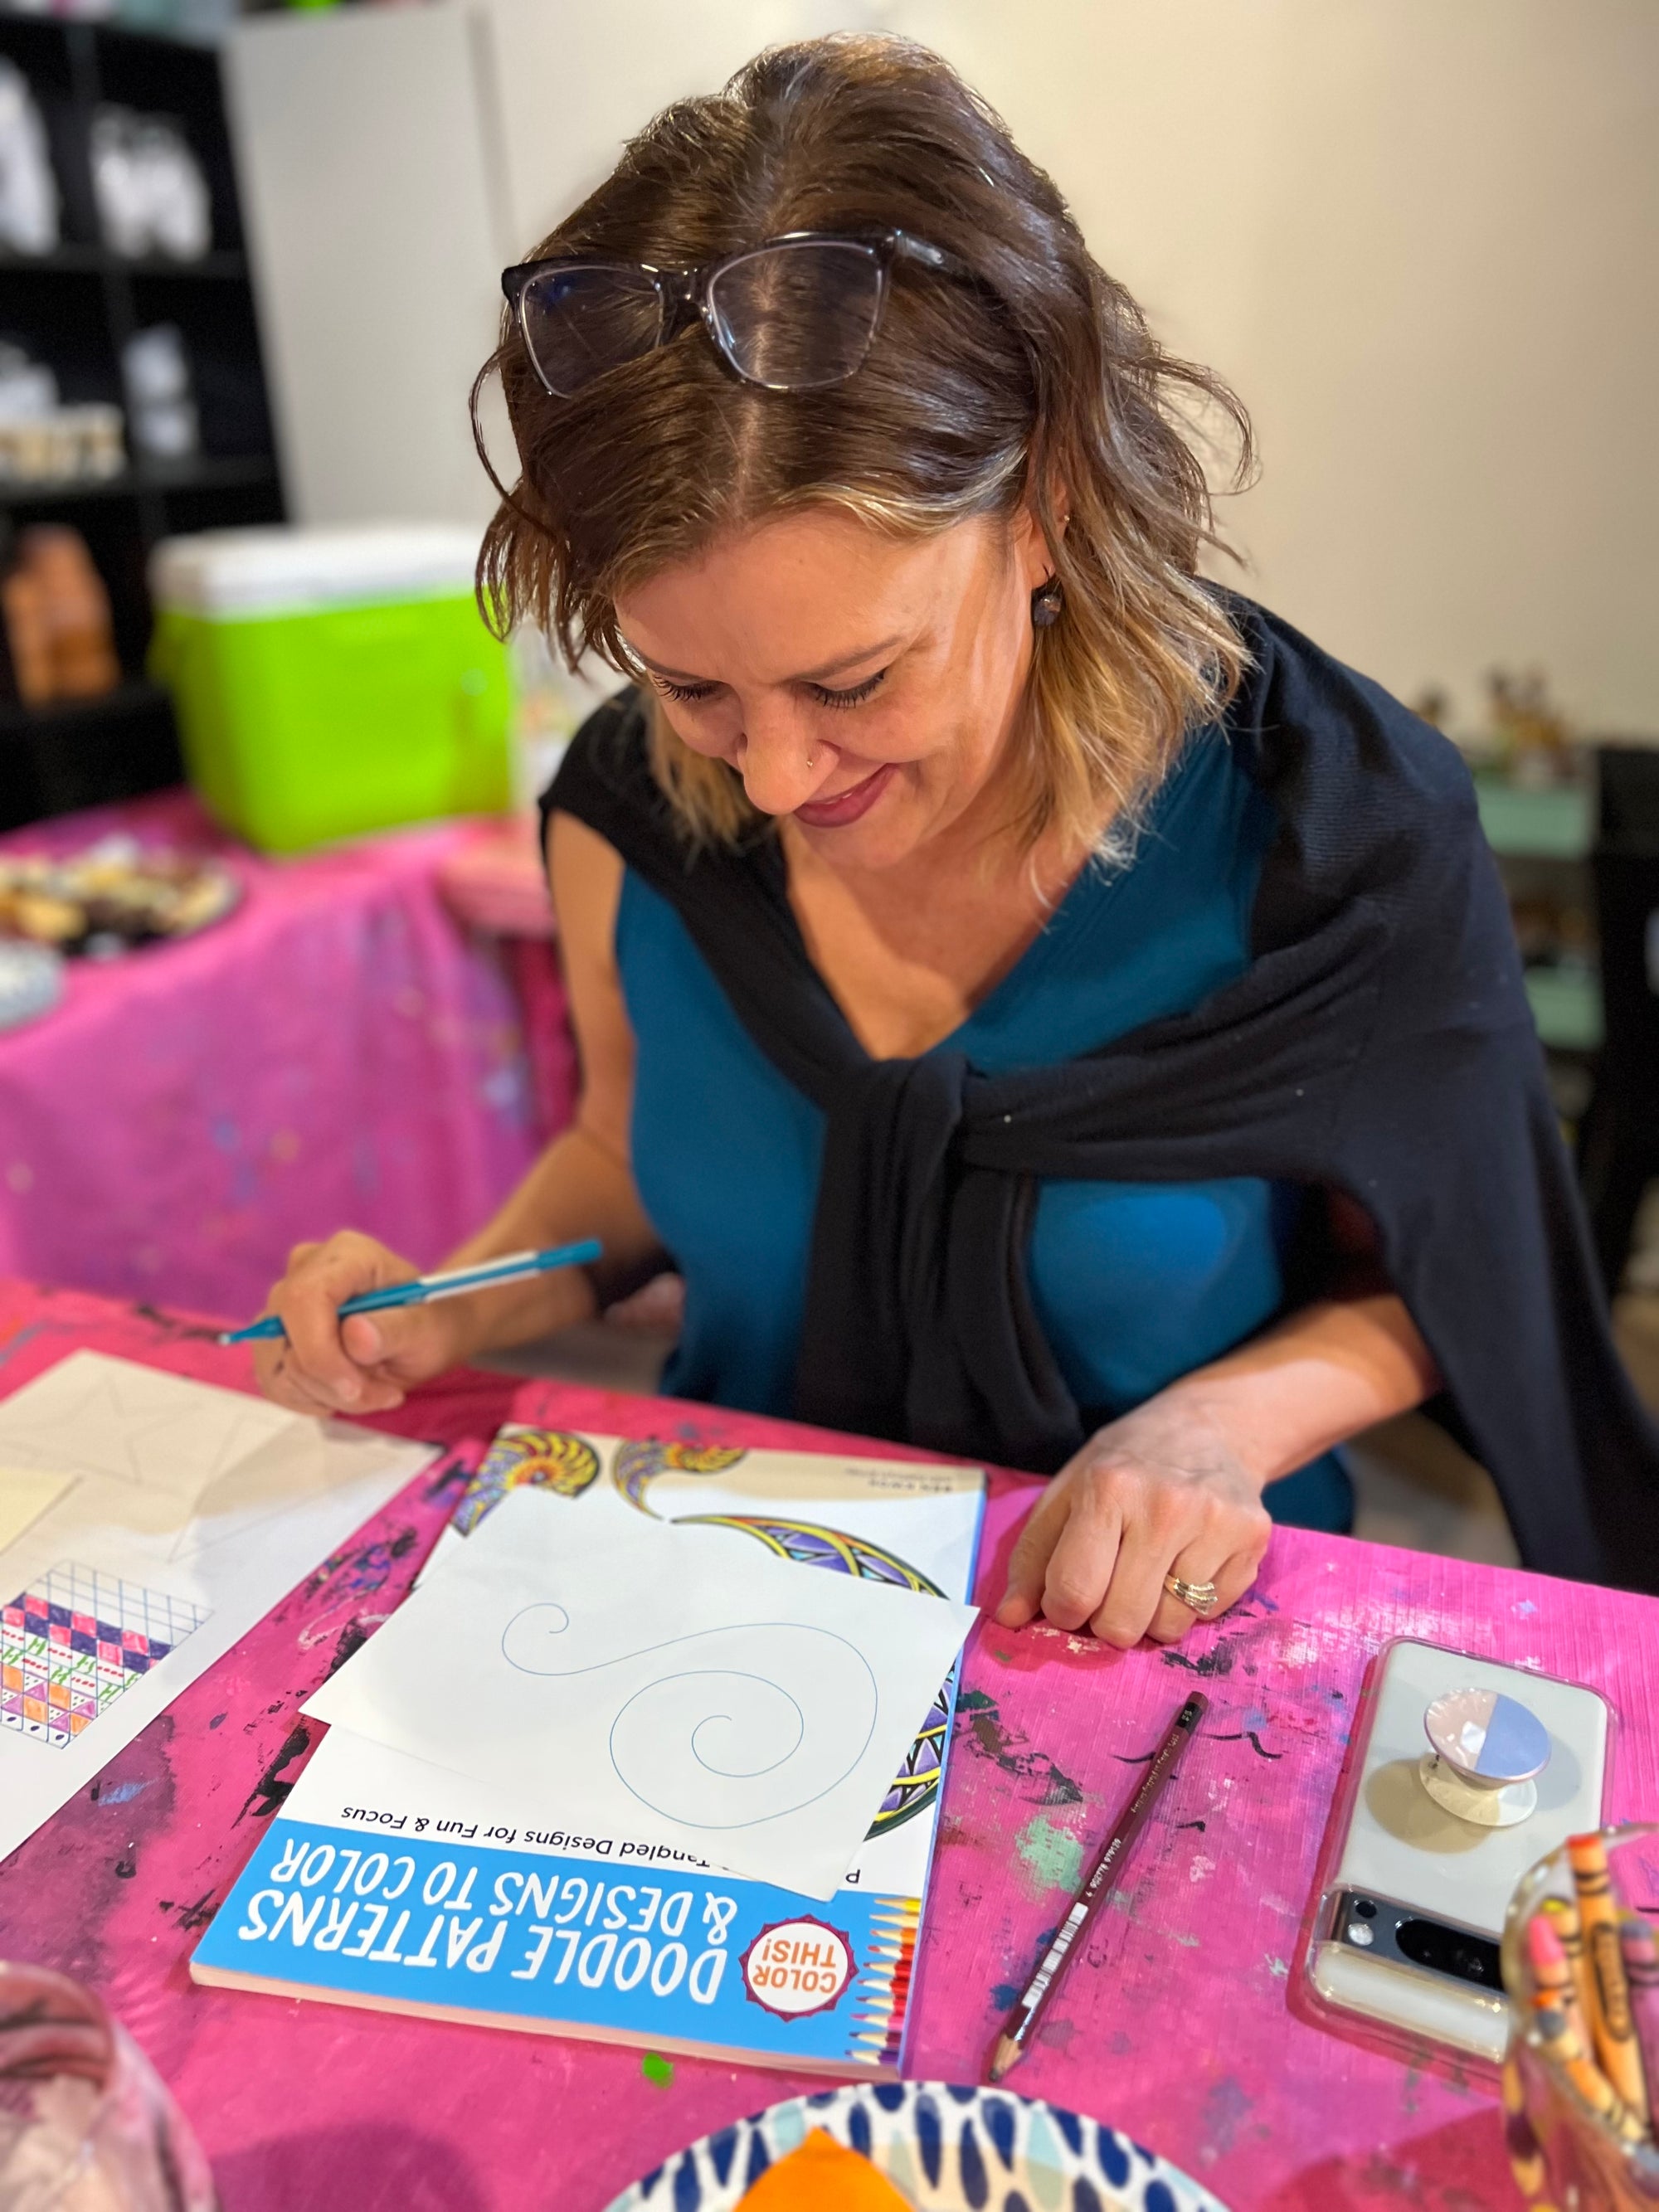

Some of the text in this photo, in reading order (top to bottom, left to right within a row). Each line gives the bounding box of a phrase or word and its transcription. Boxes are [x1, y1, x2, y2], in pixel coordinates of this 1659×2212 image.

[341, 1806, 407, 1830] Focus
[415, 1817, 431, 1832] &
[436, 1821, 478, 1839] Fun
[484, 1826, 517, 1844] for
[524, 1830, 613, 1855] Designs
[270, 1839, 737, 1945] & DESIGNS TO COLOR
[238, 1889, 727, 2005] DOODLE PATTERNS
[761, 1938, 836, 1968] THIS!
[752, 1964, 837, 1994] COLOR
